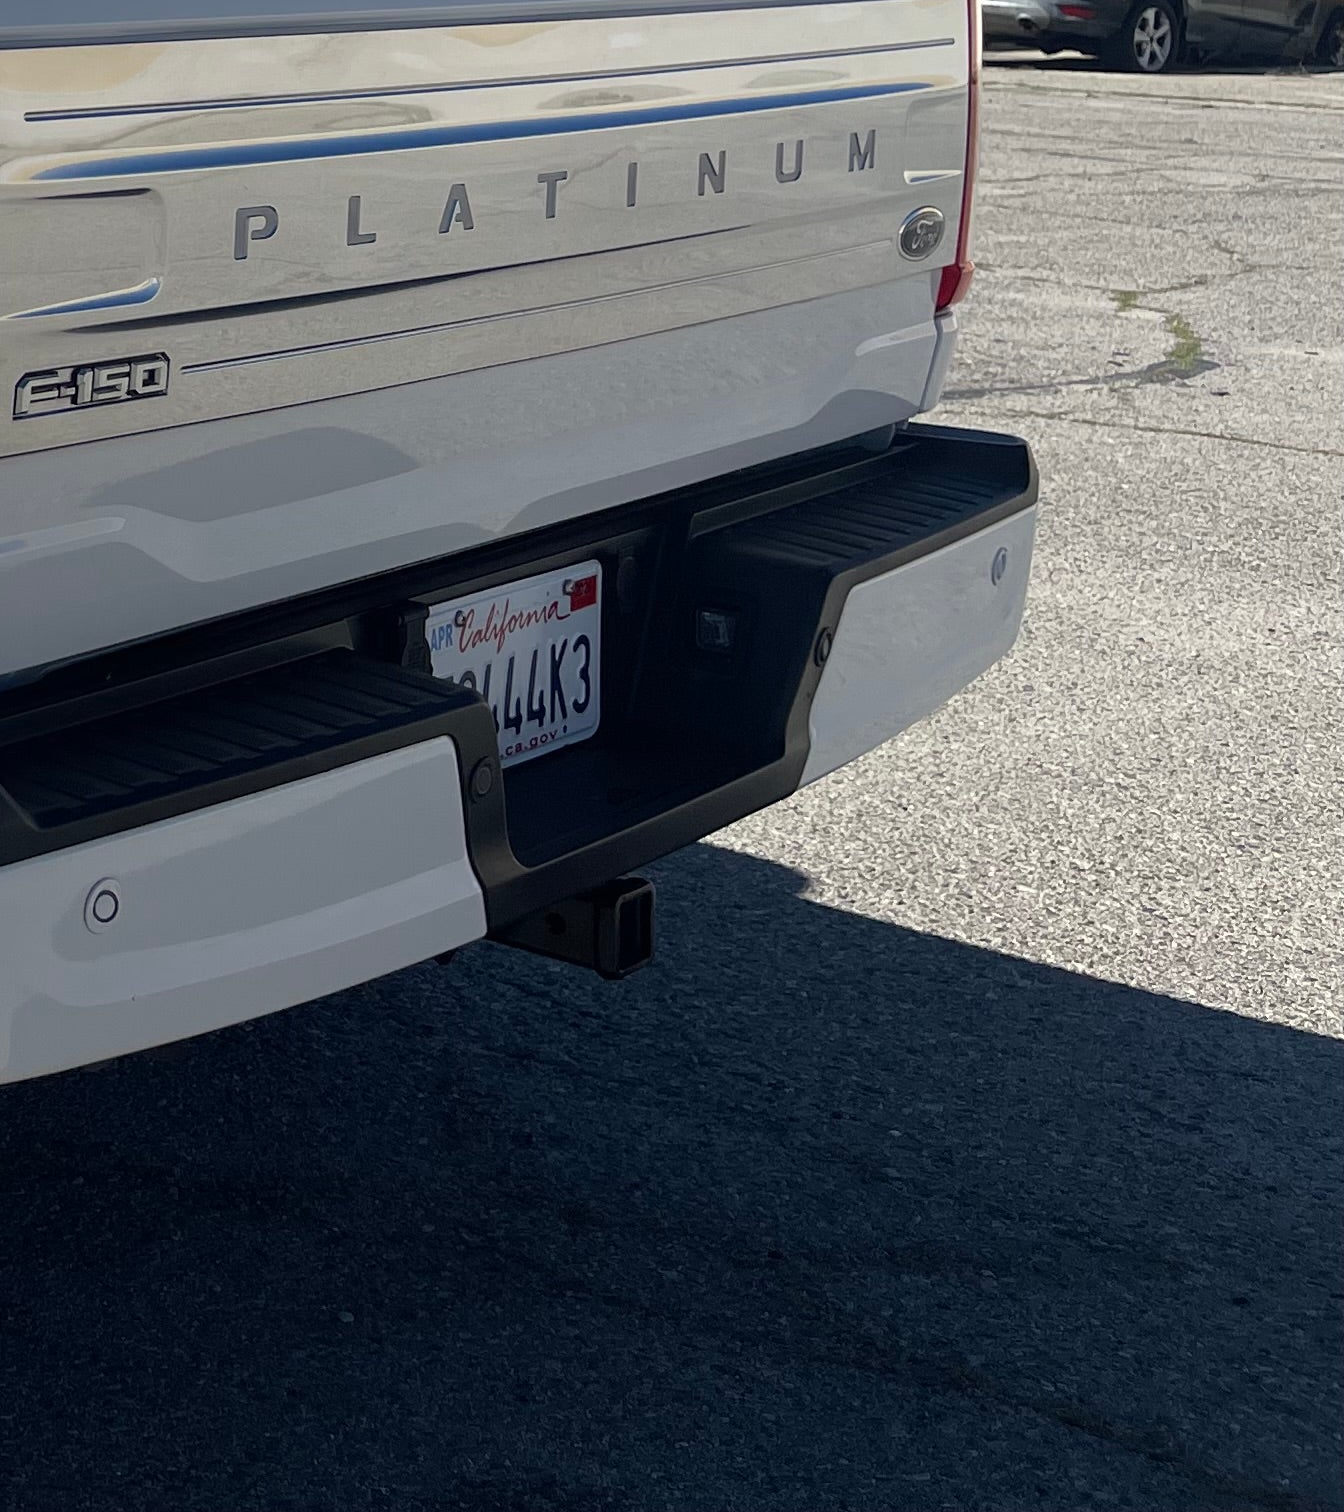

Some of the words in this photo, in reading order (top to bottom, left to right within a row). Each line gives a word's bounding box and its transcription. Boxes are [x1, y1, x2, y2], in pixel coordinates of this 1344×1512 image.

[233, 128, 877, 261] PLATINUM
[13, 352, 171, 420] F-150
[430, 622, 454, 652] APR
[458, 598, 570, 653] California
